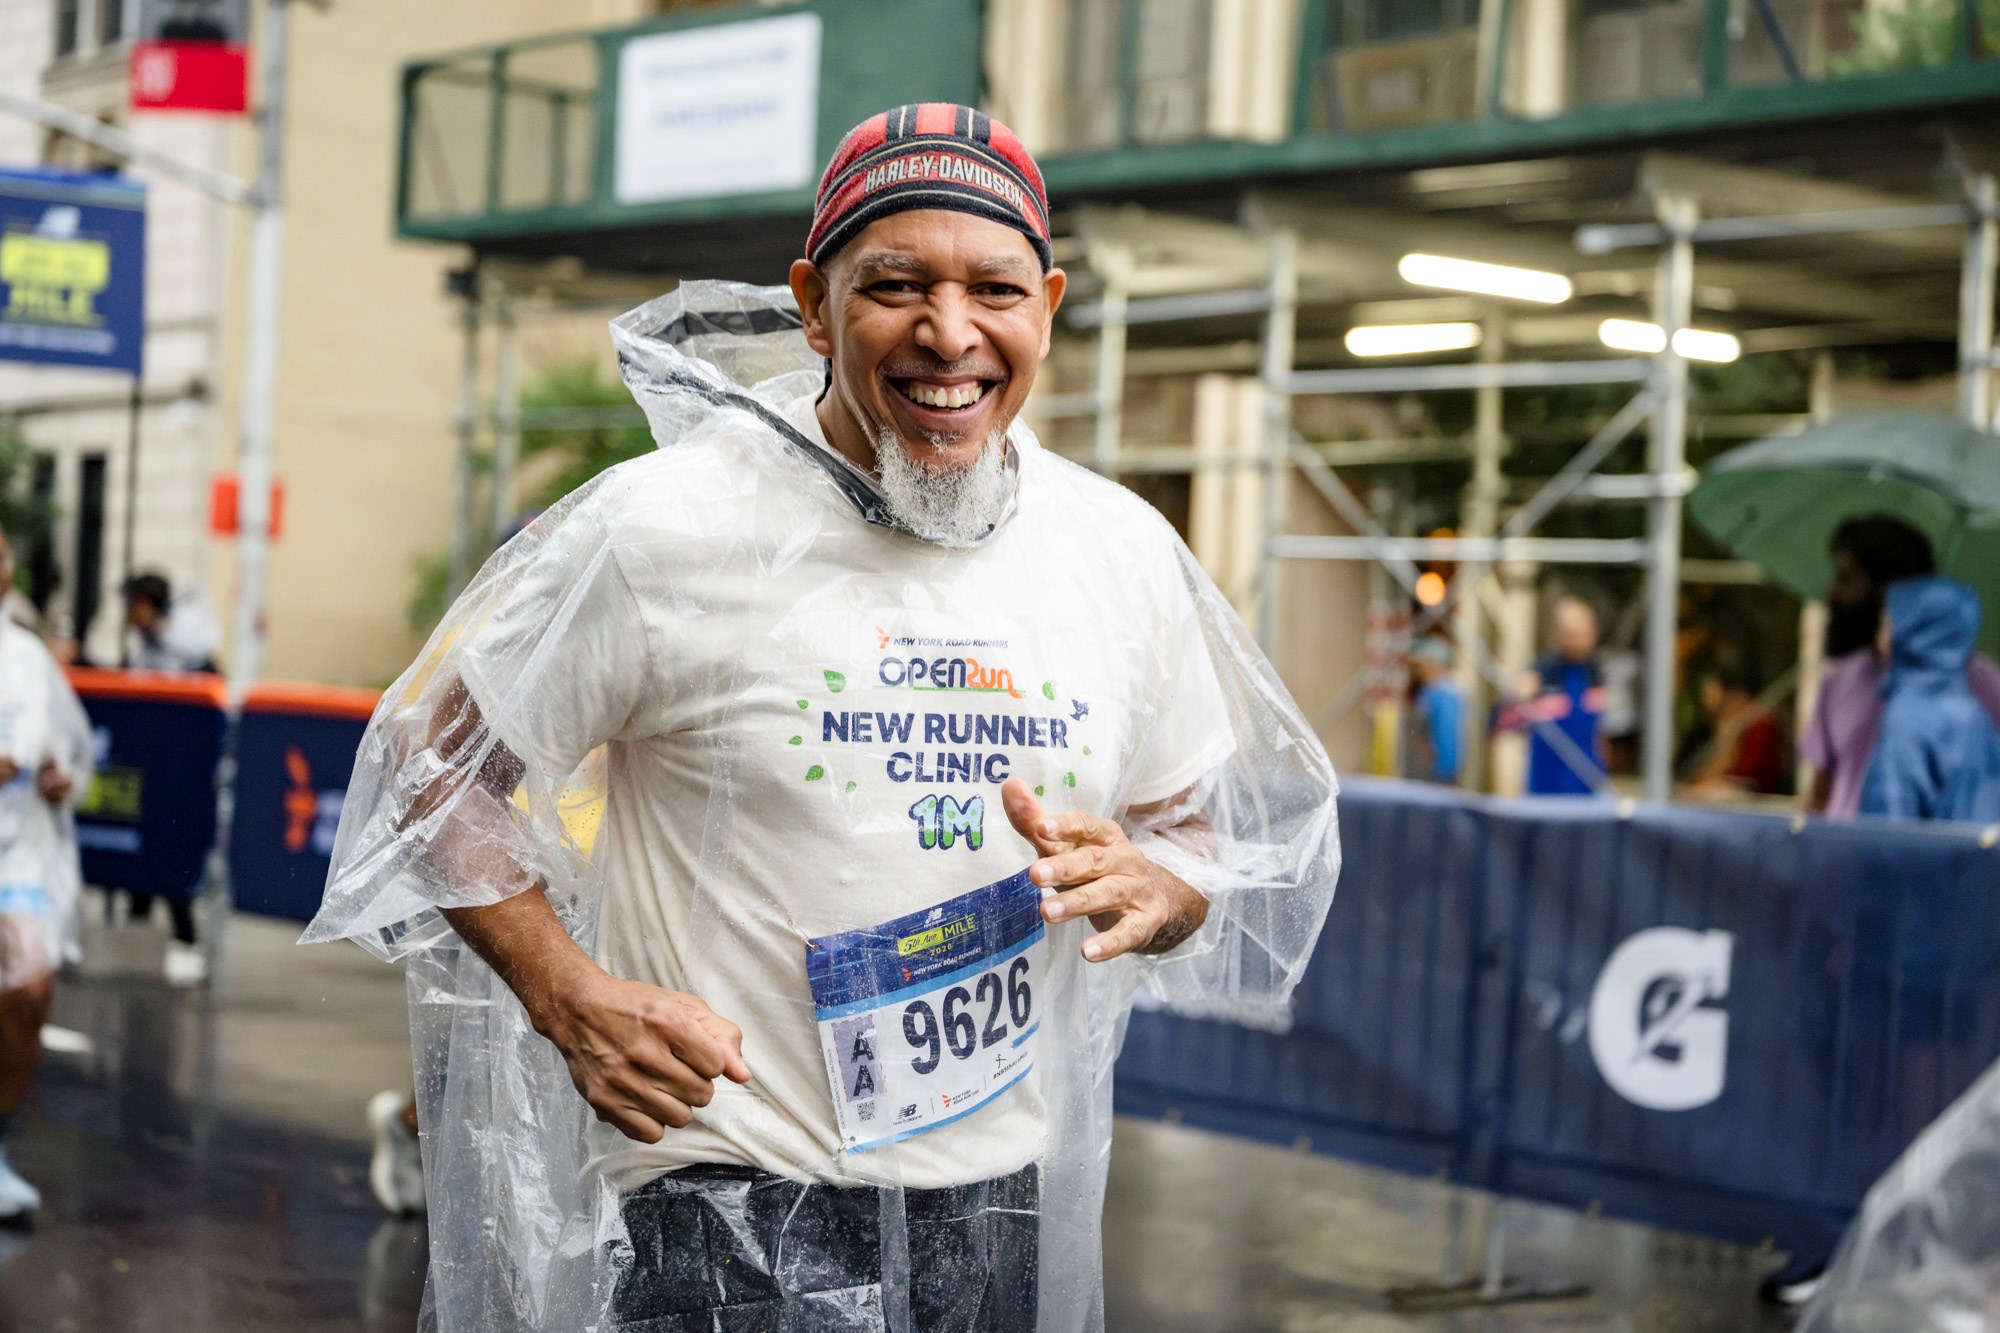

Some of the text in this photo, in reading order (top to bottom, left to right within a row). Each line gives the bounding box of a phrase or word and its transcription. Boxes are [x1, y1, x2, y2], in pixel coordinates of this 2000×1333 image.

[864, 154, 1025, 212] HARLEY-DAVIDSON
[893, 637, 1009, 648] NEW YORK ROAD RUNNERS
[822, 710, 1069, 748] NEW RUNNER
[886, 751, 1010, 784] CLINIC
[908, 793, 985, 850] 1M
[944, 916, 975, 939] MILE
[913, 946, 982, 976] NEW YORK ROAD RUNNERS
[930, 943, 953, 956] 2020
[902, 956, 1031, 1075] 9626
[1588, 926, 1736, 1112] G
[851, 1031, 875, 1063] A
[853, 1065, 874, 1096] A
